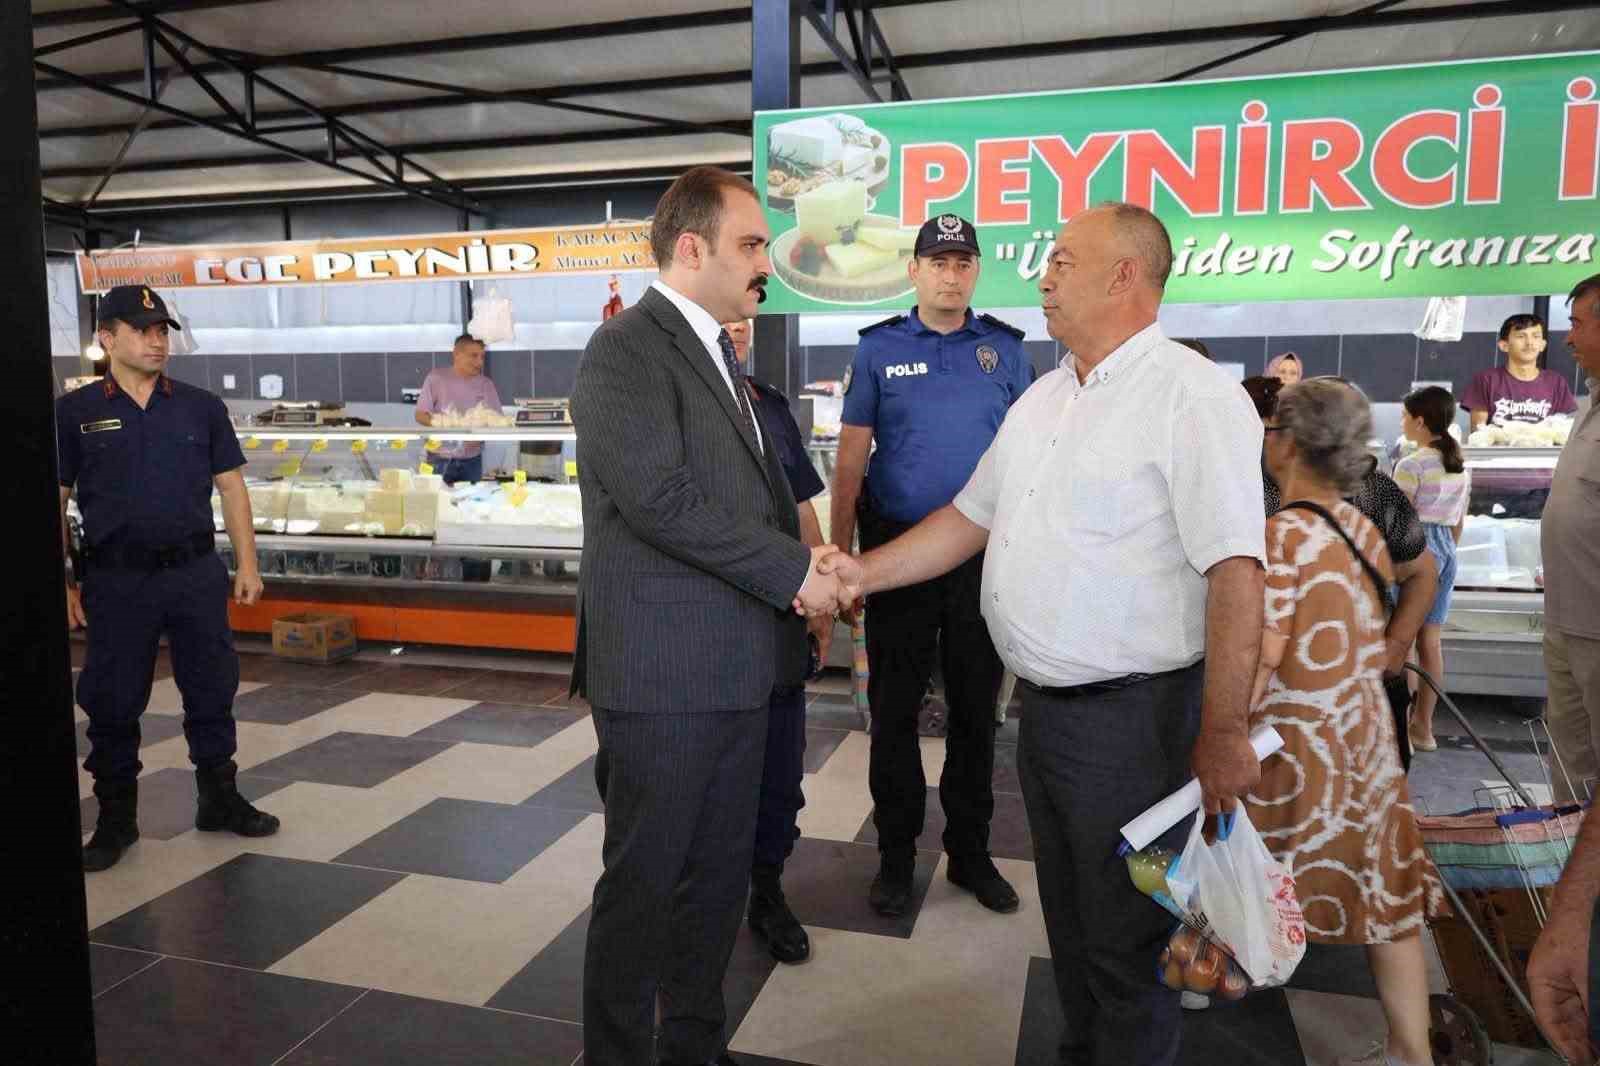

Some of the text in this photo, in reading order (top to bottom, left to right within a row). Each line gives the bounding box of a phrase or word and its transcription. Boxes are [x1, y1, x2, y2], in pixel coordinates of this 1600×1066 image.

[899, 83, 1506, 229] PEYNİRCİ
[193, 254, 301, 285] EGE
[313, 238, 541, 280] PEYNİR
[555, 230, 651, 249] KARACAS
[1312, 224, 1597, 281] Sofranıza
